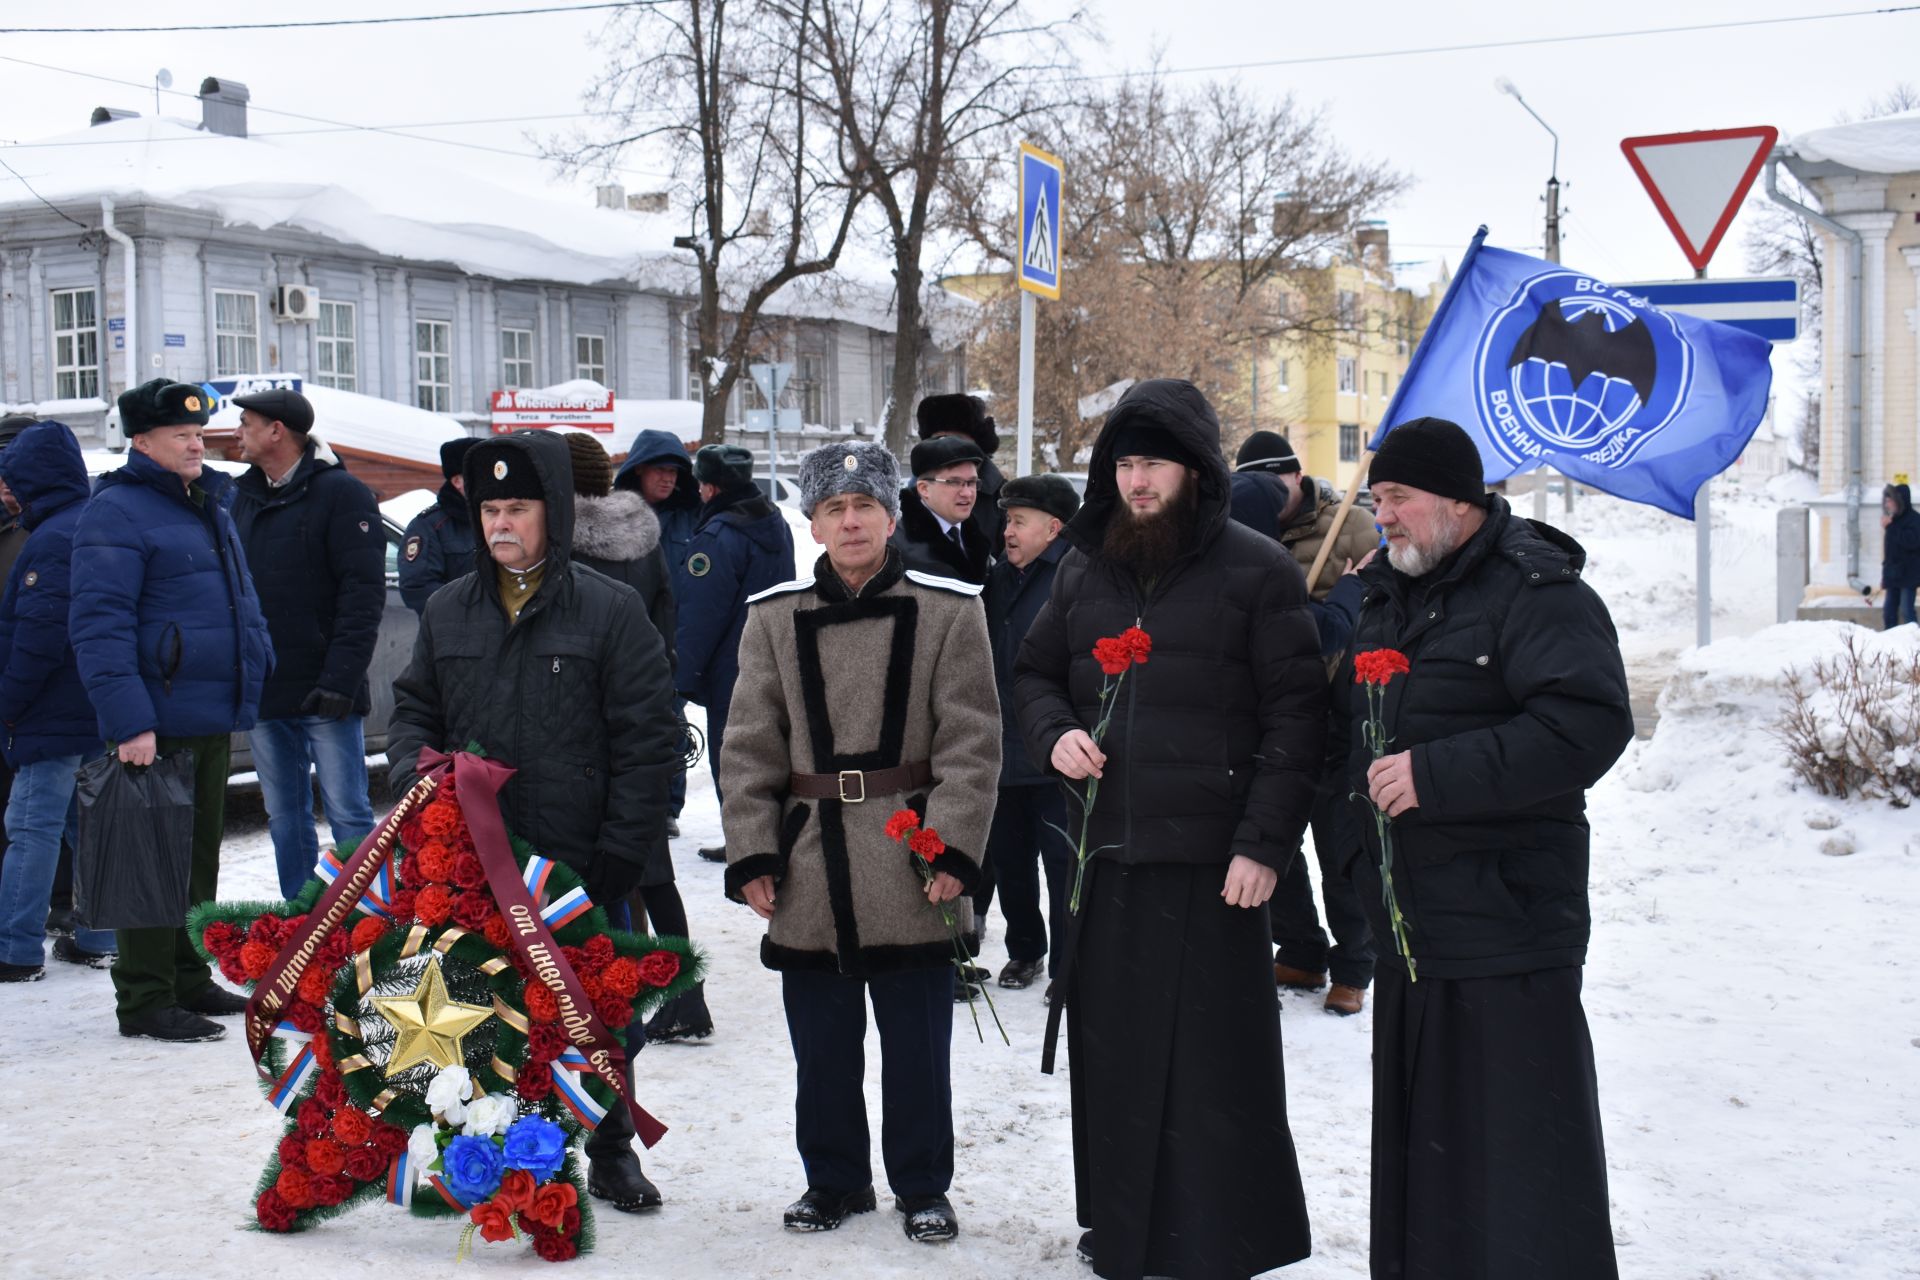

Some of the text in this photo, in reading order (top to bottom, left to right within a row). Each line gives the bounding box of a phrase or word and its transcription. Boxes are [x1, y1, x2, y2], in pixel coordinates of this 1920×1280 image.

[1575, 278, 1608, 293] ВС
[514, 392, 609, 411] Wienerberger
[1580, 427, 1641, 465] ВЕДКА
[509, 904, 539, 937] от
